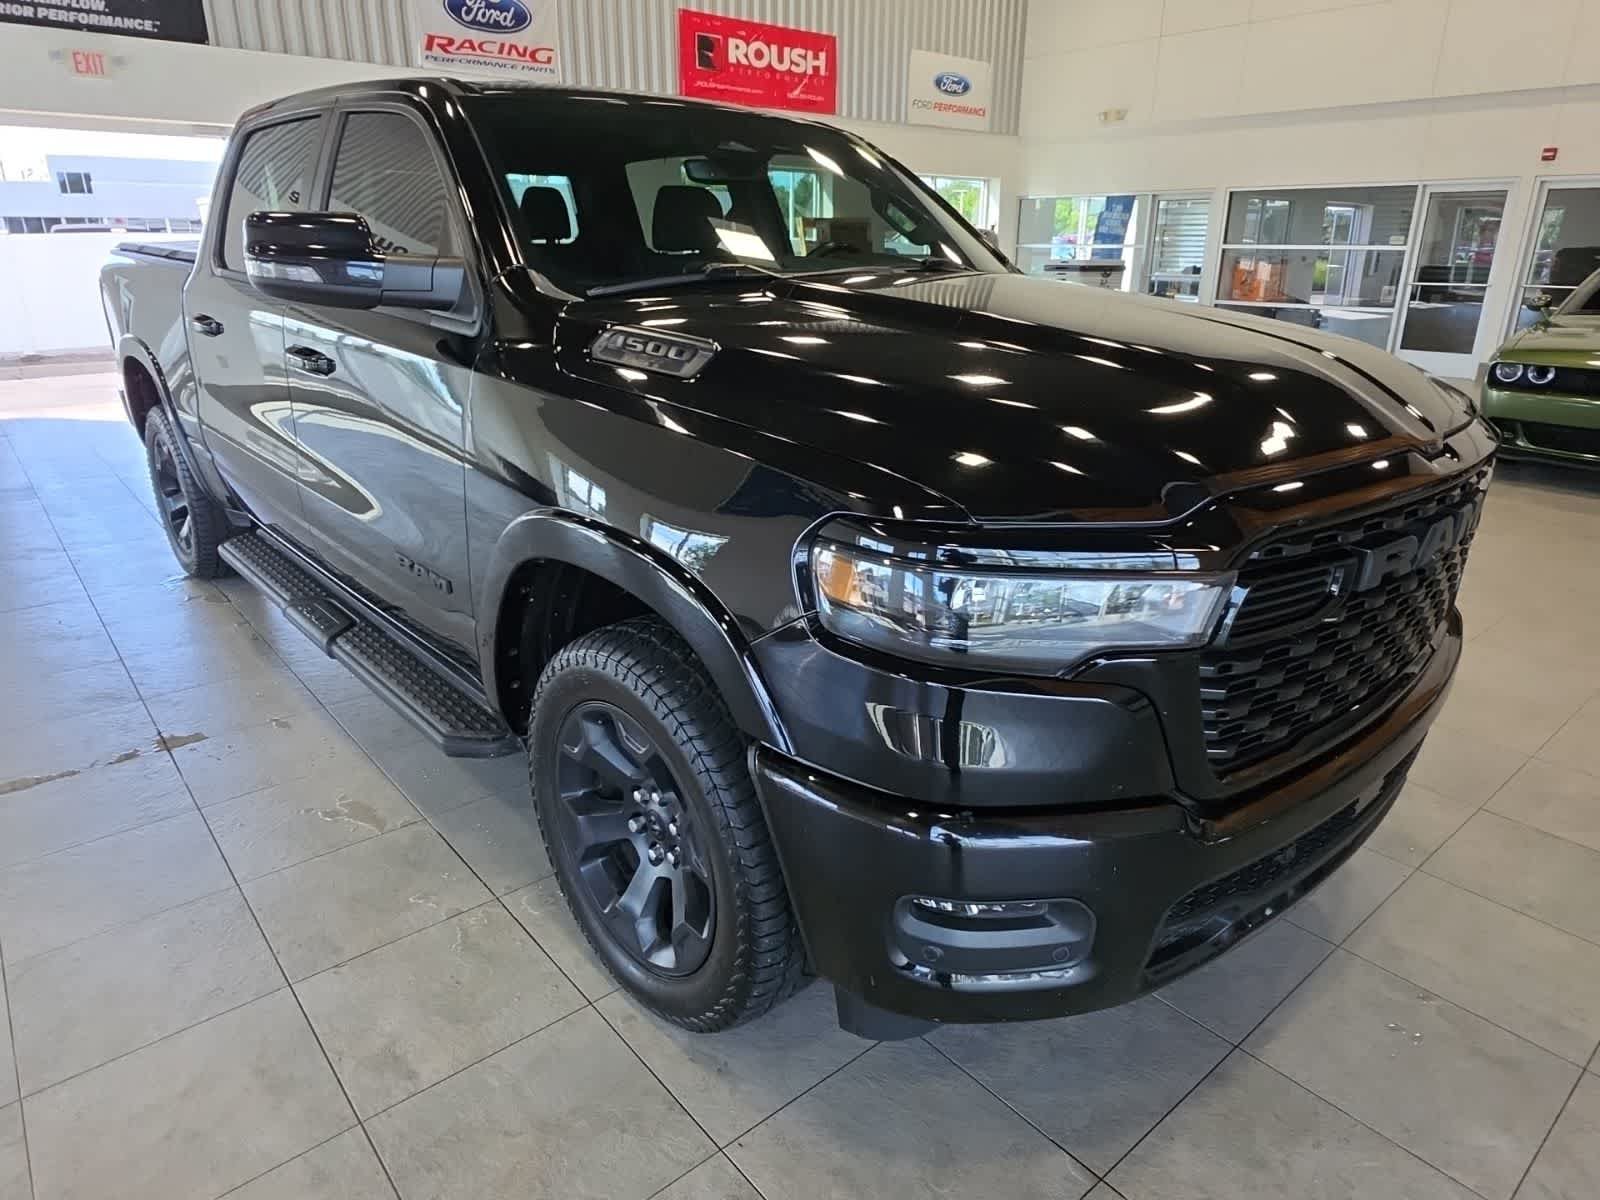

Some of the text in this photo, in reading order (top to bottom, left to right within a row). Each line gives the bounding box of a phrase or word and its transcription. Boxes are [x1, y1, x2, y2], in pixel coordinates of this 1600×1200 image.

[461, 0, 515, 27] Ford
[425, 35, 554, 64] RACING
[425, 54, 517, 71] PERFORMANCE
[727, 36, 826, 76] ROUSH
[72, 52, 105, 75] EXIT
[940, 75, 965, 93] Ford
[608, 334, 695, 361] 1500
